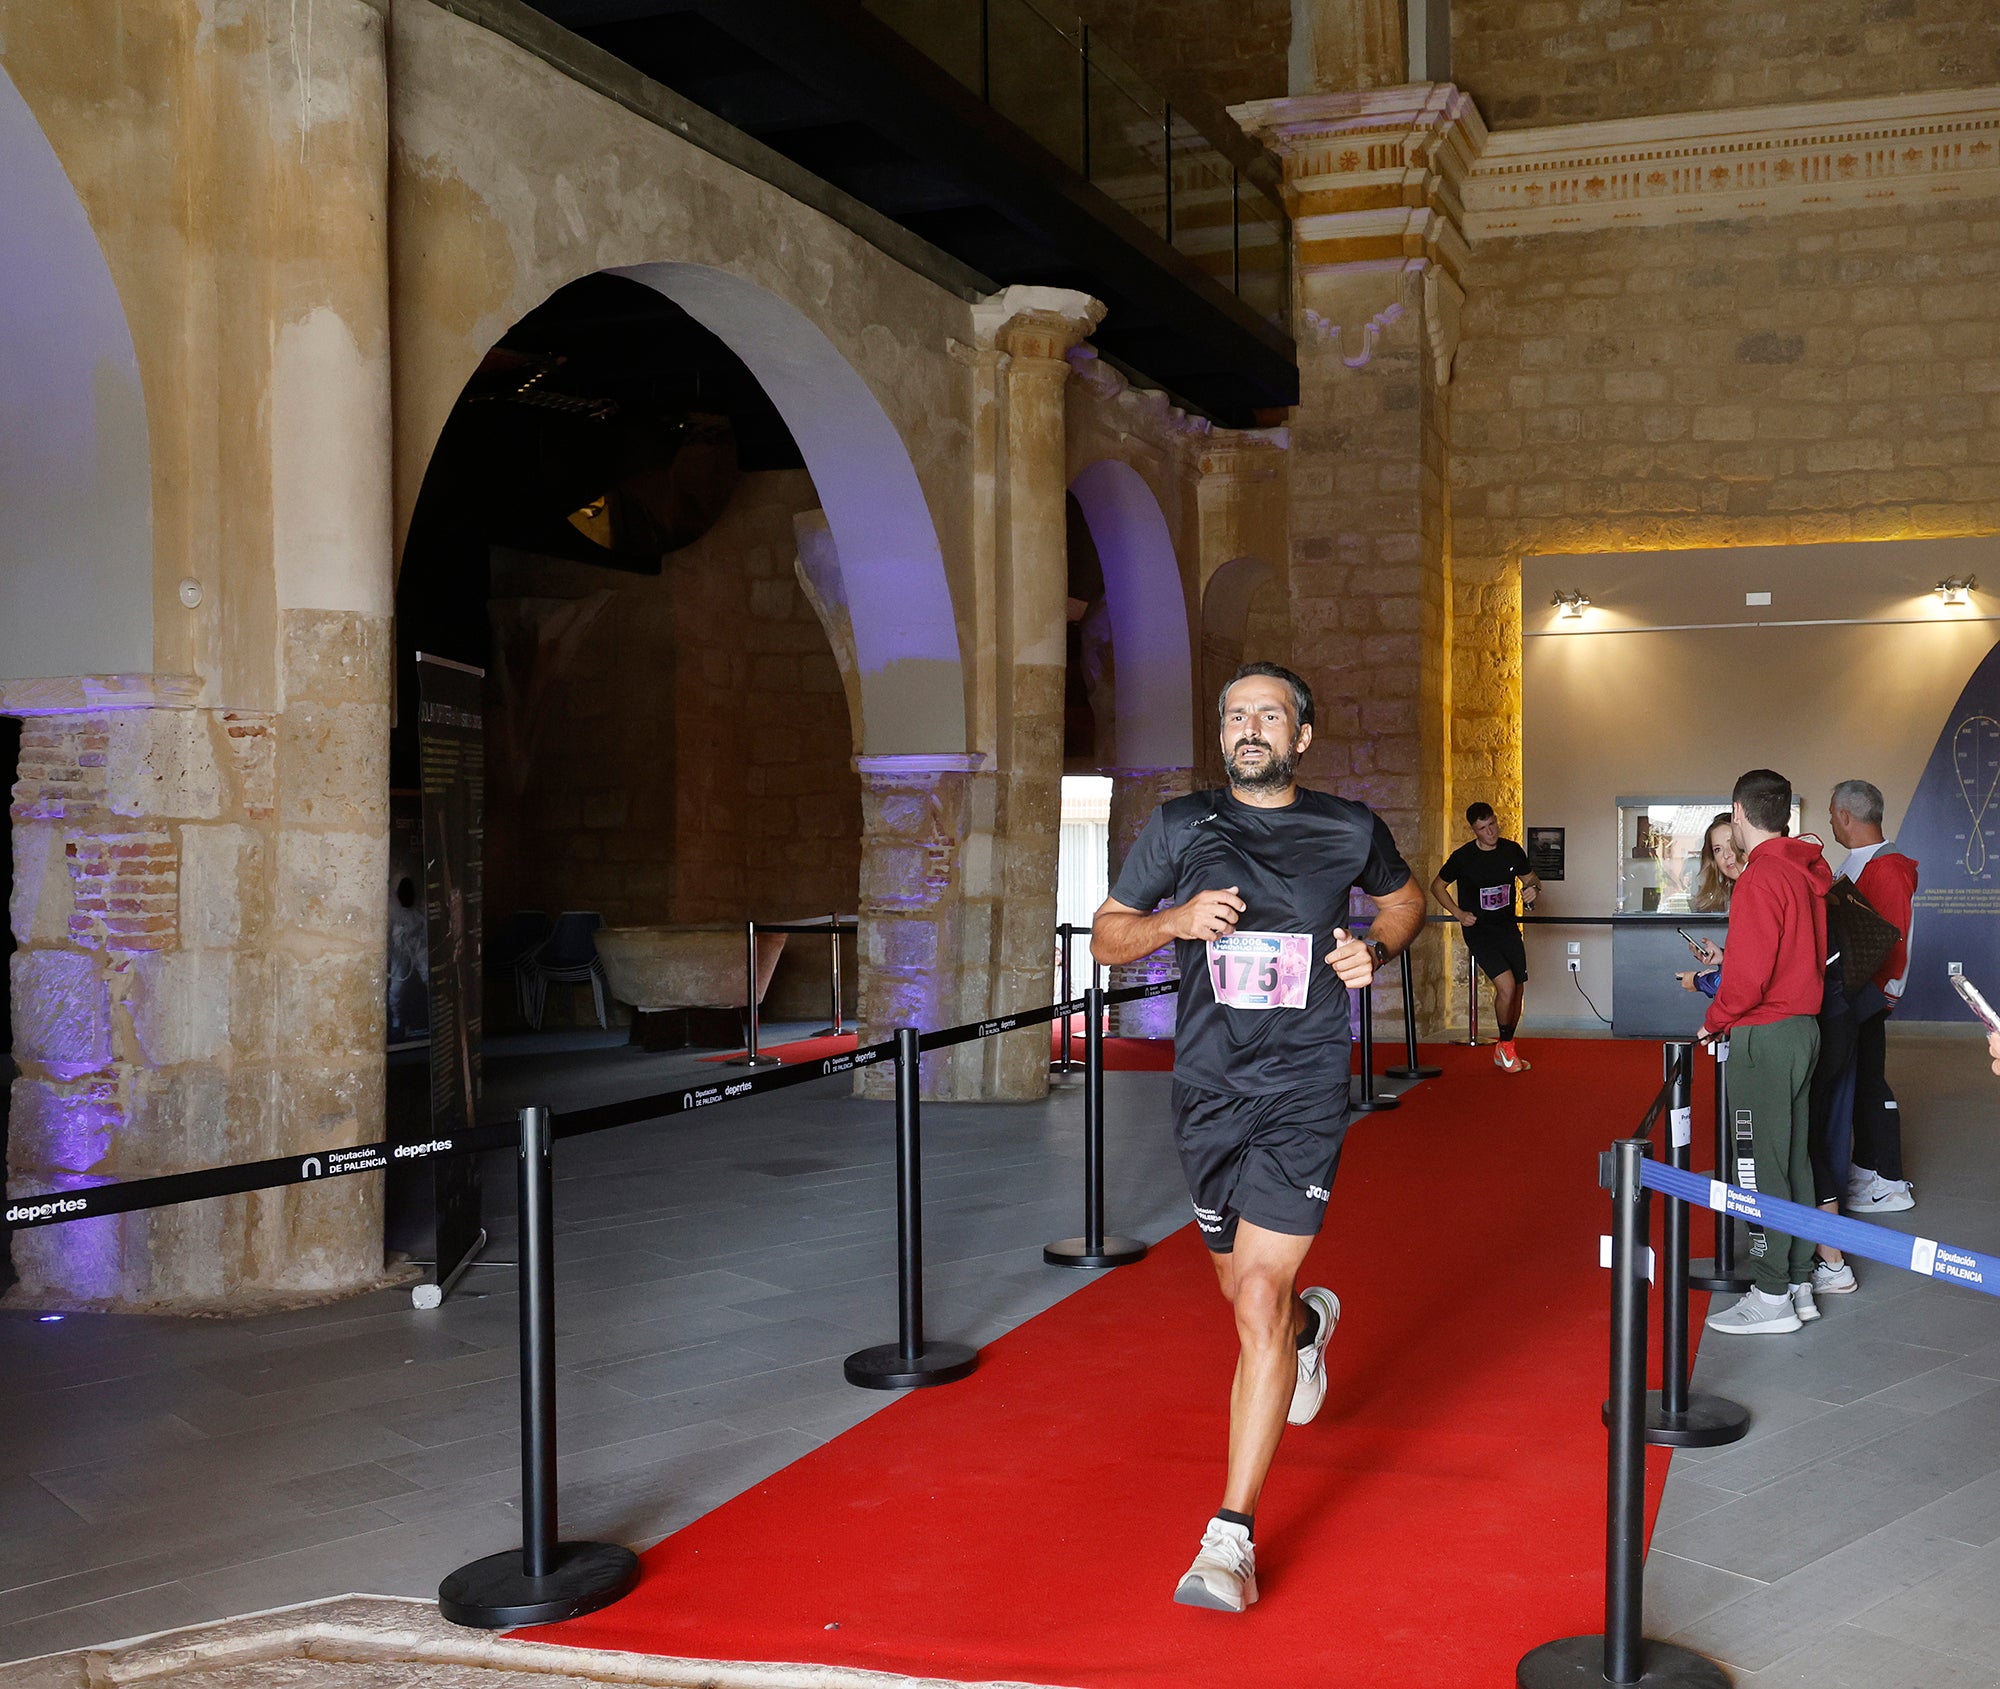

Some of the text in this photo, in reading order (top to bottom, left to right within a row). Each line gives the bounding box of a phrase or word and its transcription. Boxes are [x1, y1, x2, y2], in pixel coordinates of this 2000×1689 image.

[1482, 893, 1503, 905] 153
[1214, 955, 1278, 992] 175
[855, 1051, 876, 1063] deportes
[725, 1082, 752, 1095] deportes
[702, 1095, 722, 1104] PALENCIA
[329, 1148, 376, 1162] Diputación
[394, 1139, 452, 1158] deportes
[329, 1157, 387, 1174] DE PALENCIA
[1728, 1190, 1756, 1204] Diputación
[6, 1199, 87, 1221] deportes
[1727, 1200, 1762, 1218] DE PALENCIA
[1937, 1249, 1976, 1268] Diputación
[1935, 1262, 1982, 1283] DE PALENCIA
